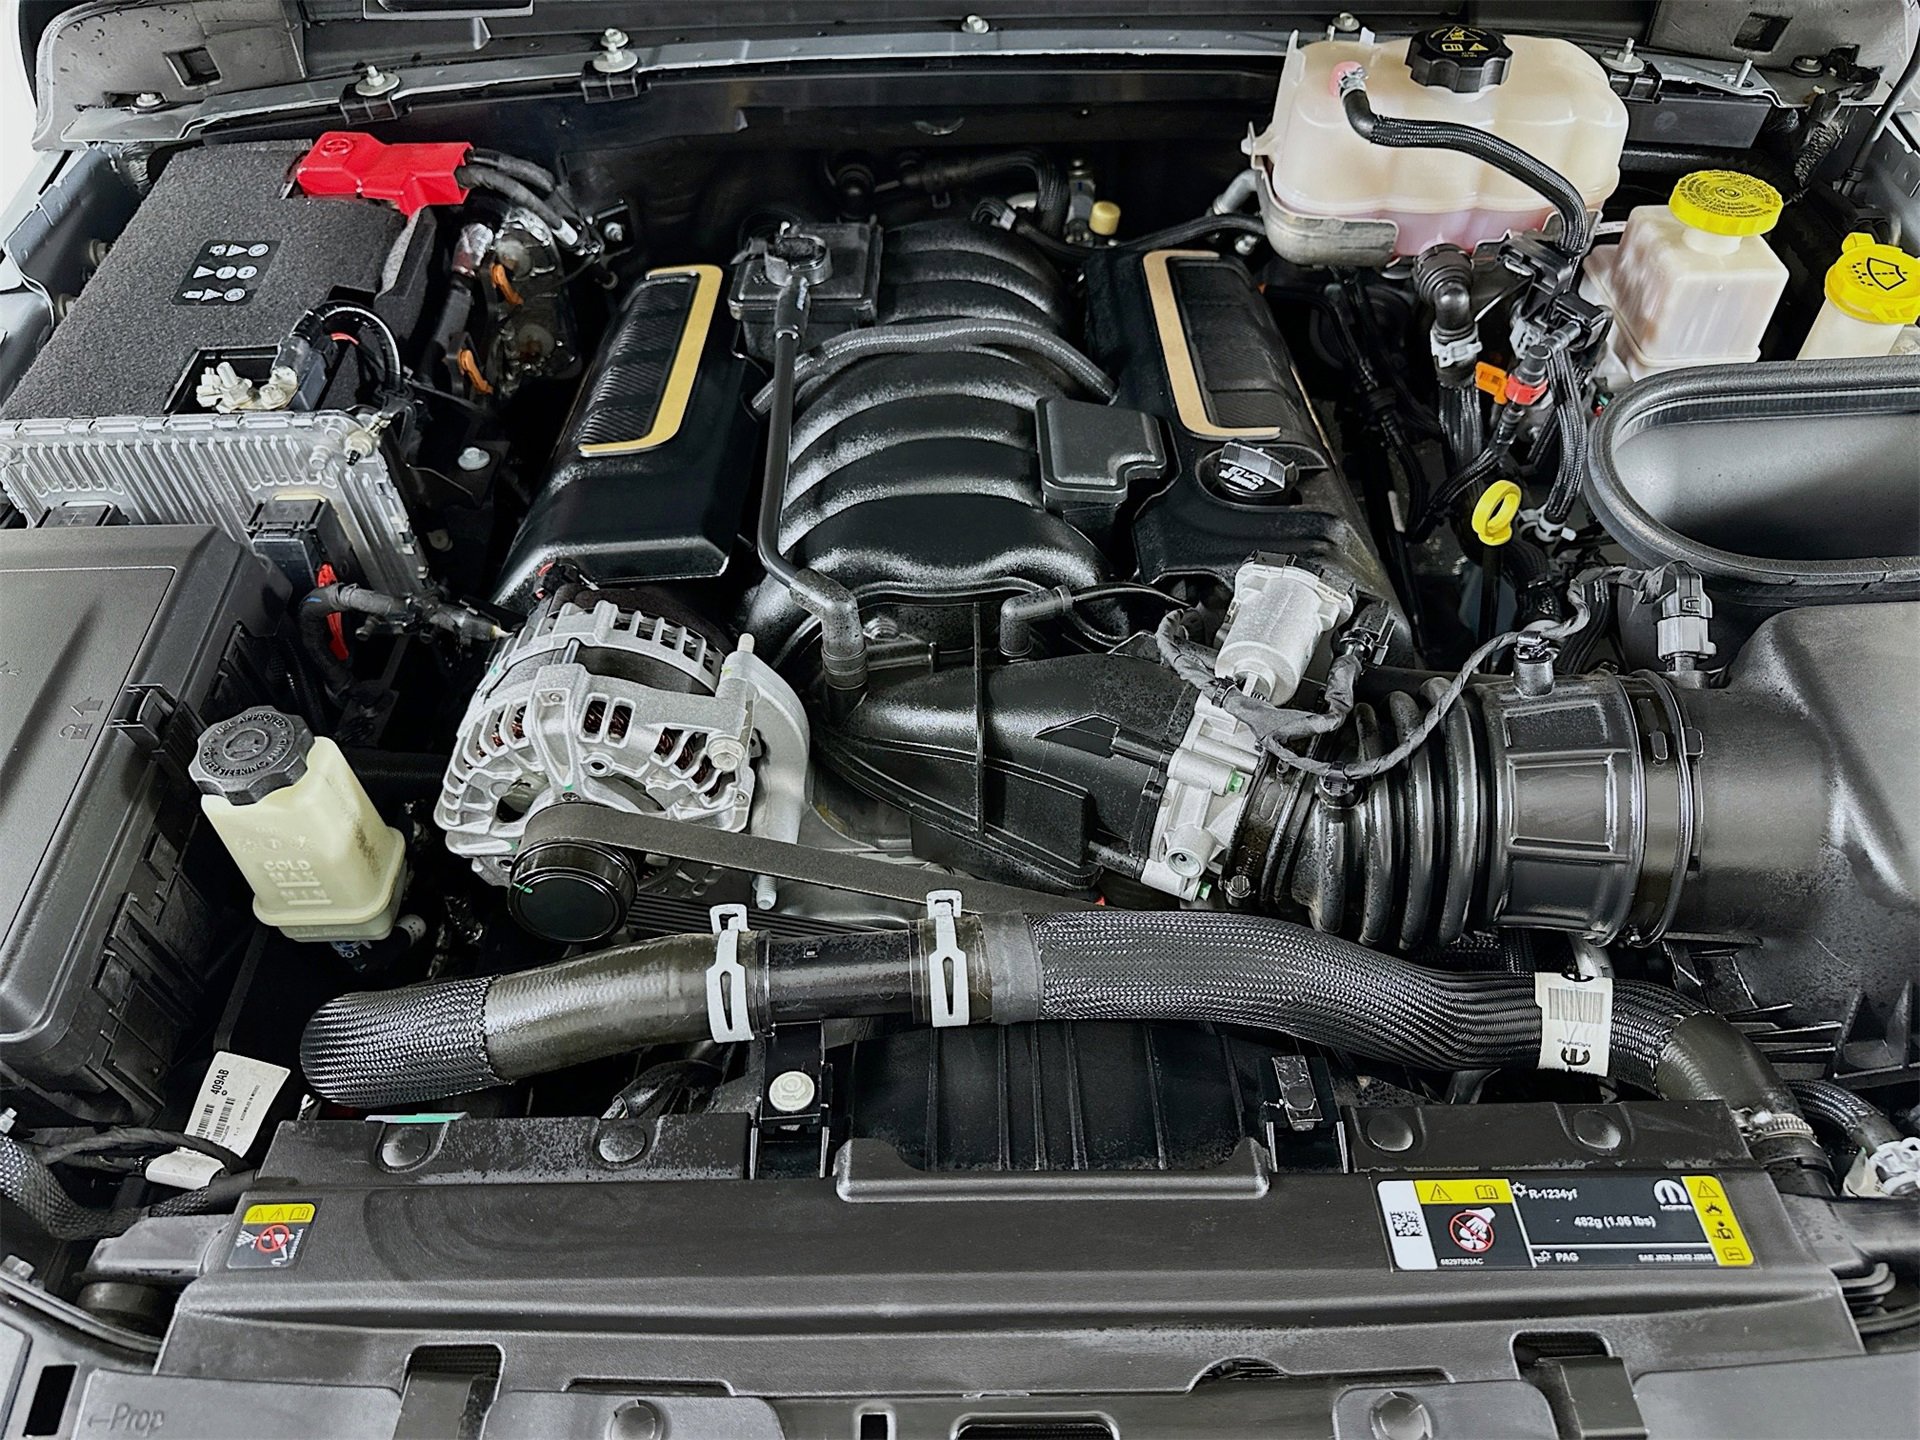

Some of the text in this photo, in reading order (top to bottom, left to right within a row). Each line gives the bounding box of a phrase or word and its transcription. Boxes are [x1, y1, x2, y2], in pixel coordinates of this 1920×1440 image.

[215, 712, 286, 735] USE APPROVED
[263, 860, 311, 871] COLD
[210, 1069, 229, 1094] 409AB
[1528, 1188, 1578, 1201] R-1234yf
[1632, 1215, 1656, 1228] lbs)
[1555, 1252, 1579, 1262] PAG
[109, 1402, 164, 1437] Prop
